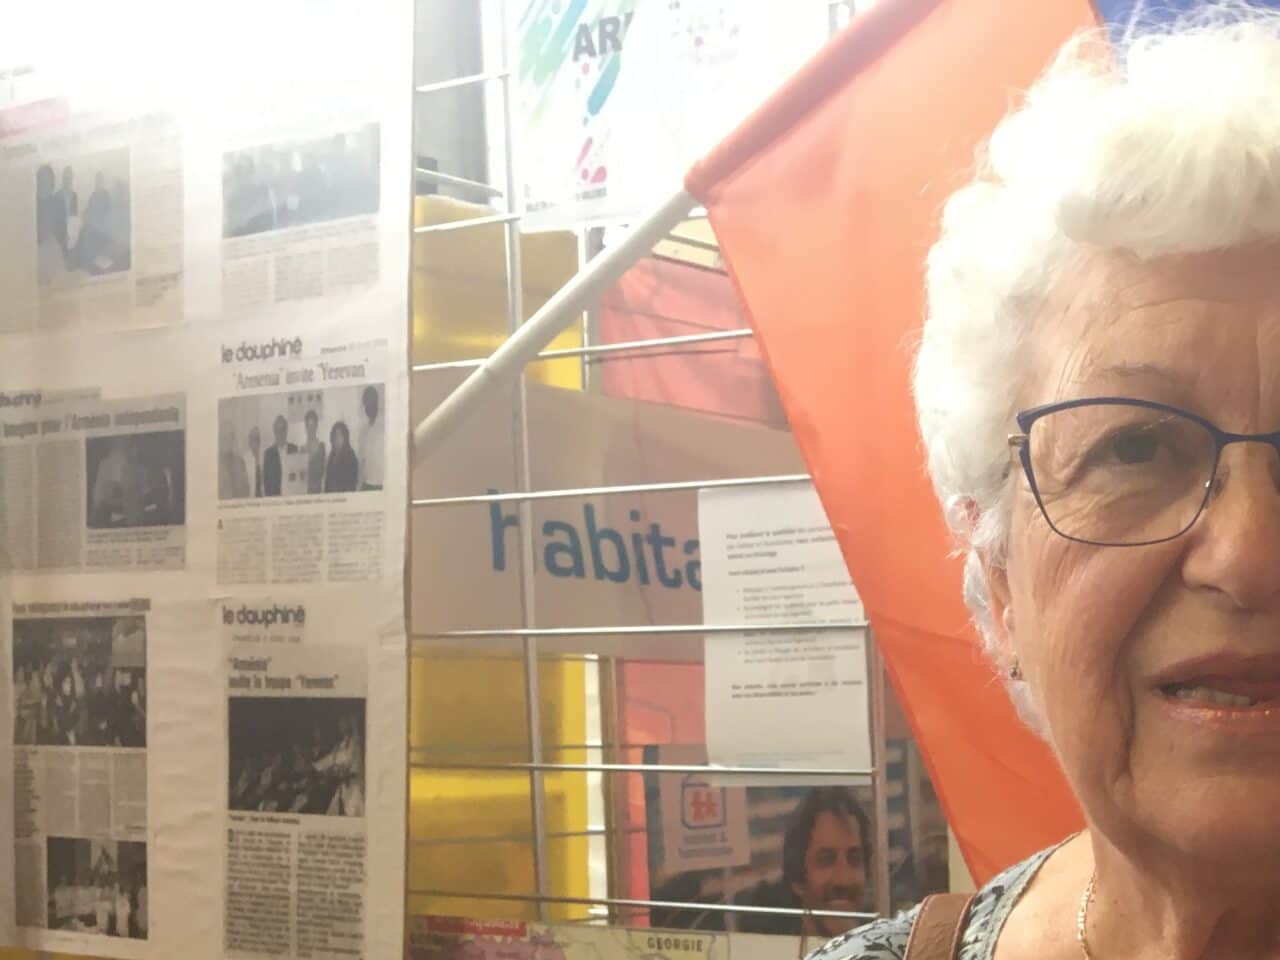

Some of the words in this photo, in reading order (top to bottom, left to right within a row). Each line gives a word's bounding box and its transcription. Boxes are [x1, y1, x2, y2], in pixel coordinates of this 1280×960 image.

[221, 344, 233, 363] le
[235, 336, 303, 363] dauphiné
[222, 605, 234, 625] le
[236, 604, 305, 628] dauphiné
[647, 936, 704, 953] GEORGIE
